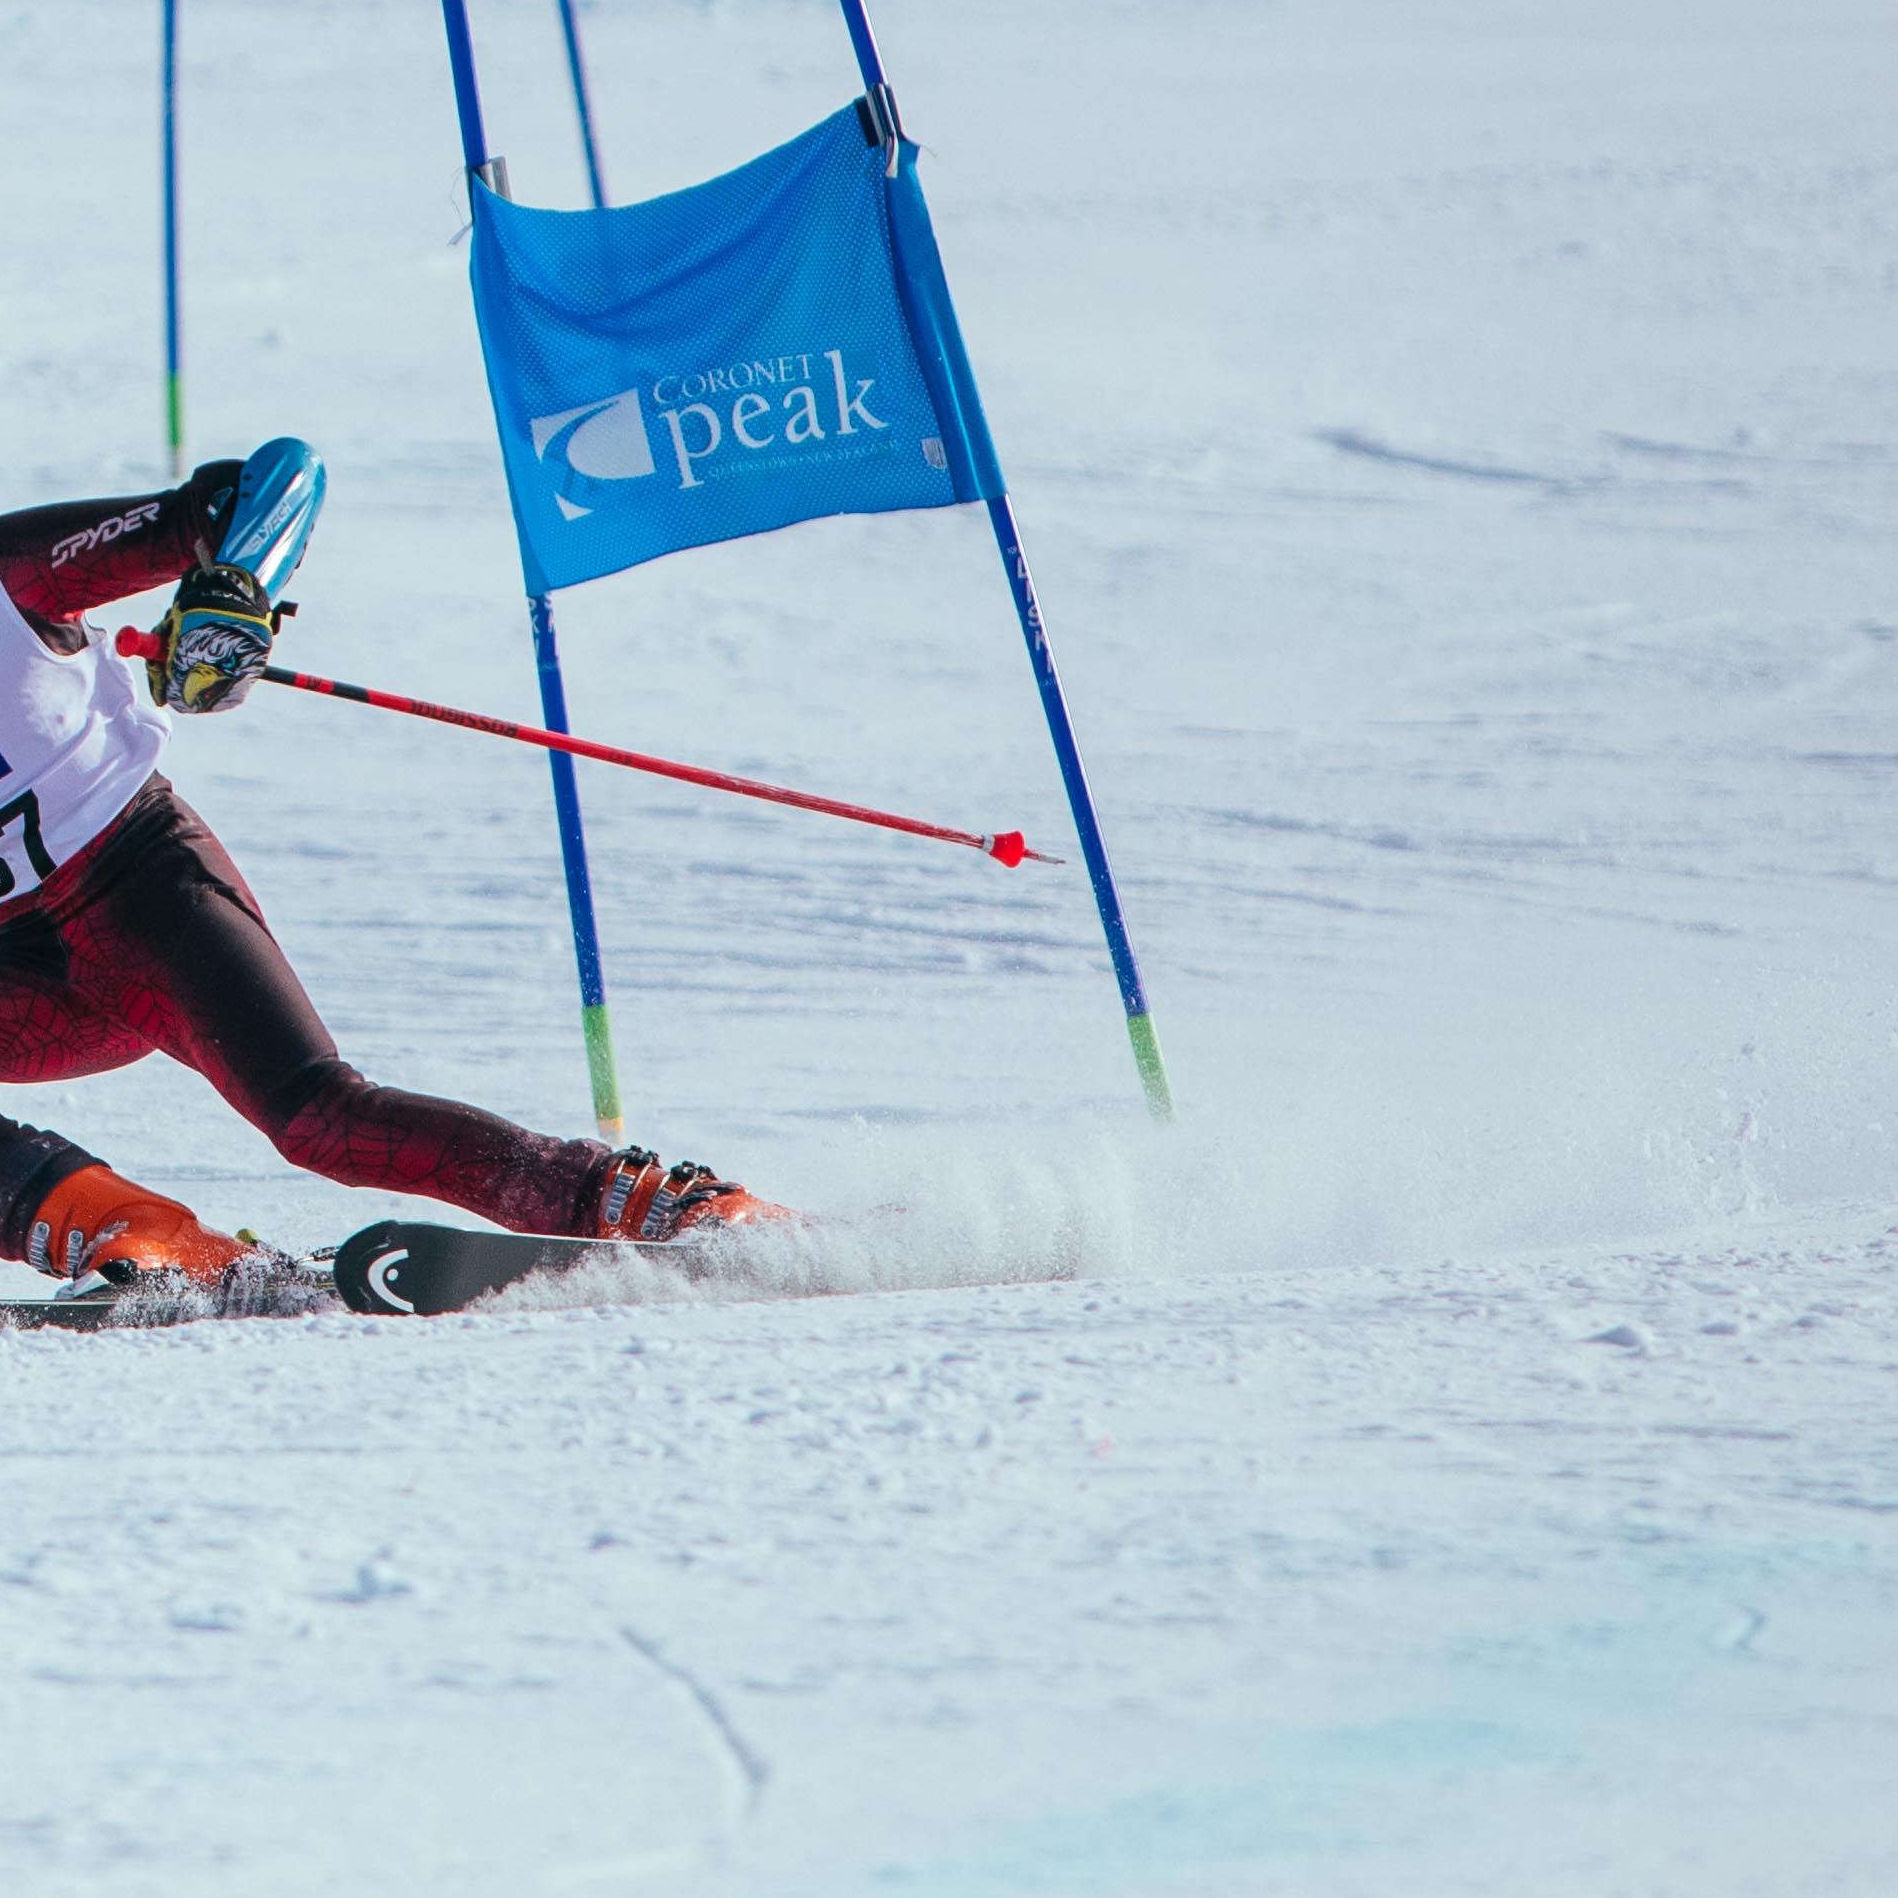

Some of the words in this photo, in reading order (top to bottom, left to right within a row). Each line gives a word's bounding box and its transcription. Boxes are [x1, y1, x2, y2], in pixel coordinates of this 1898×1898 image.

[653, 354, 813, 404] CORONET
[657, 349, 891, 490] peak
[51, 502, 160, 569] SPYDER
